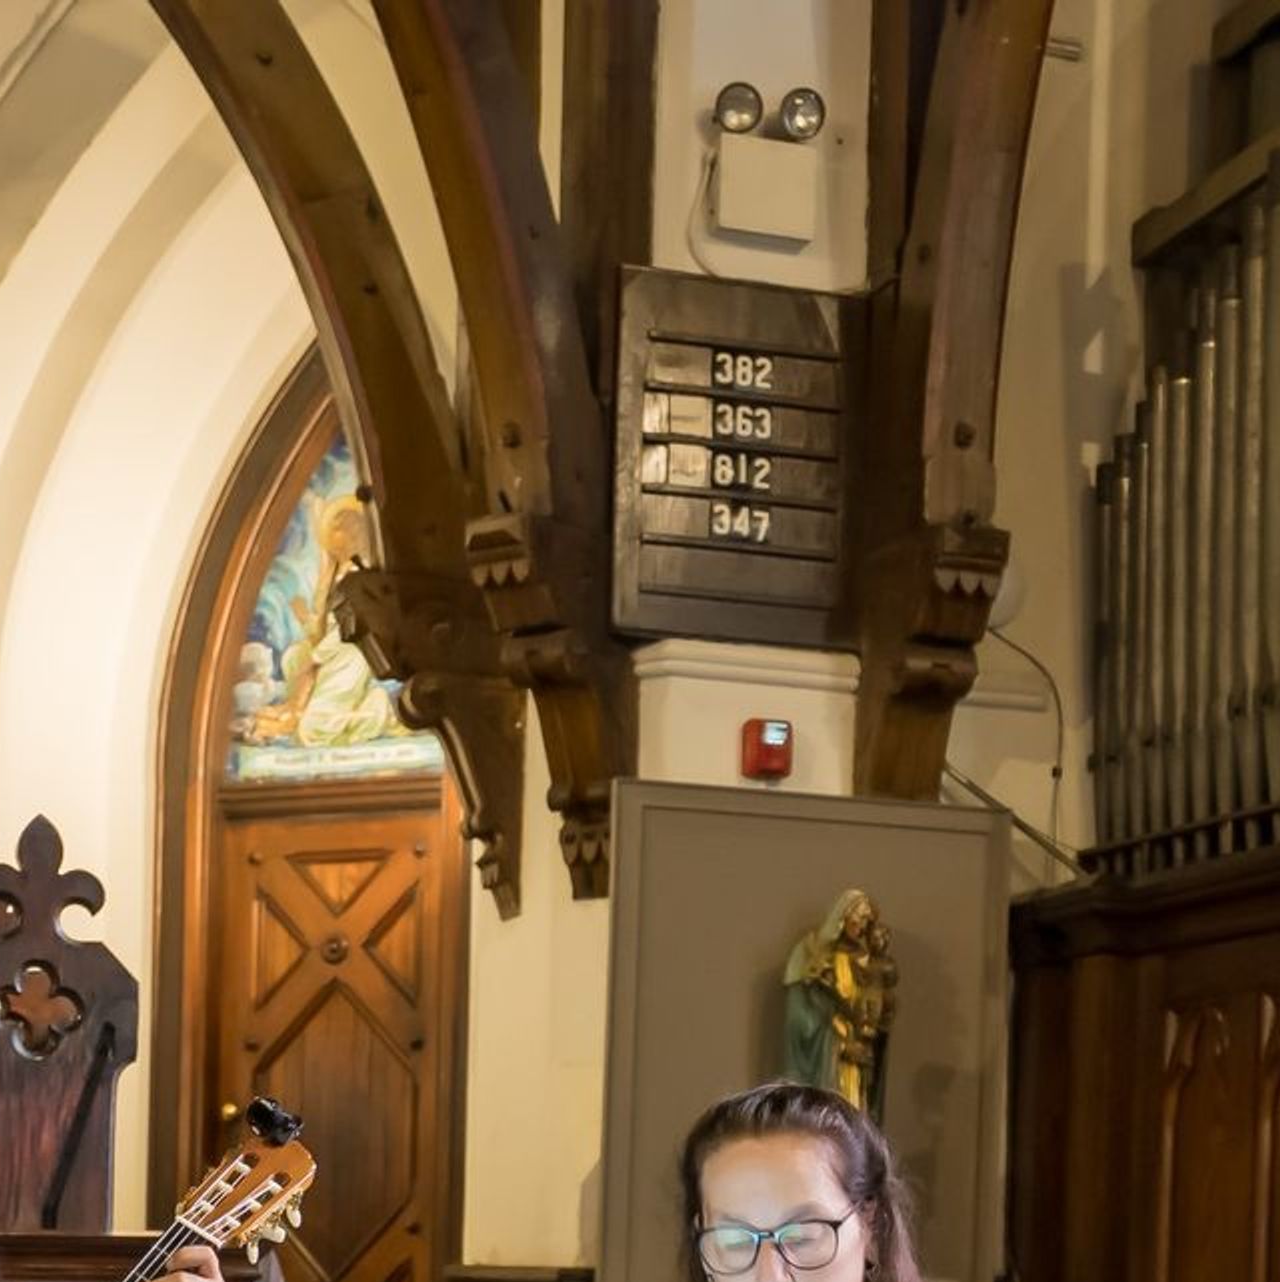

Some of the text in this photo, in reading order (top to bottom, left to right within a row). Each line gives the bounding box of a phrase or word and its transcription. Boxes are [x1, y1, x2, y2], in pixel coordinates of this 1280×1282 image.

[715, 353, 772, 388] 382
[715, 404, 771, 439] 363
[715, 453, 771, 489] 812
[712, 503, 770, 542] 347
